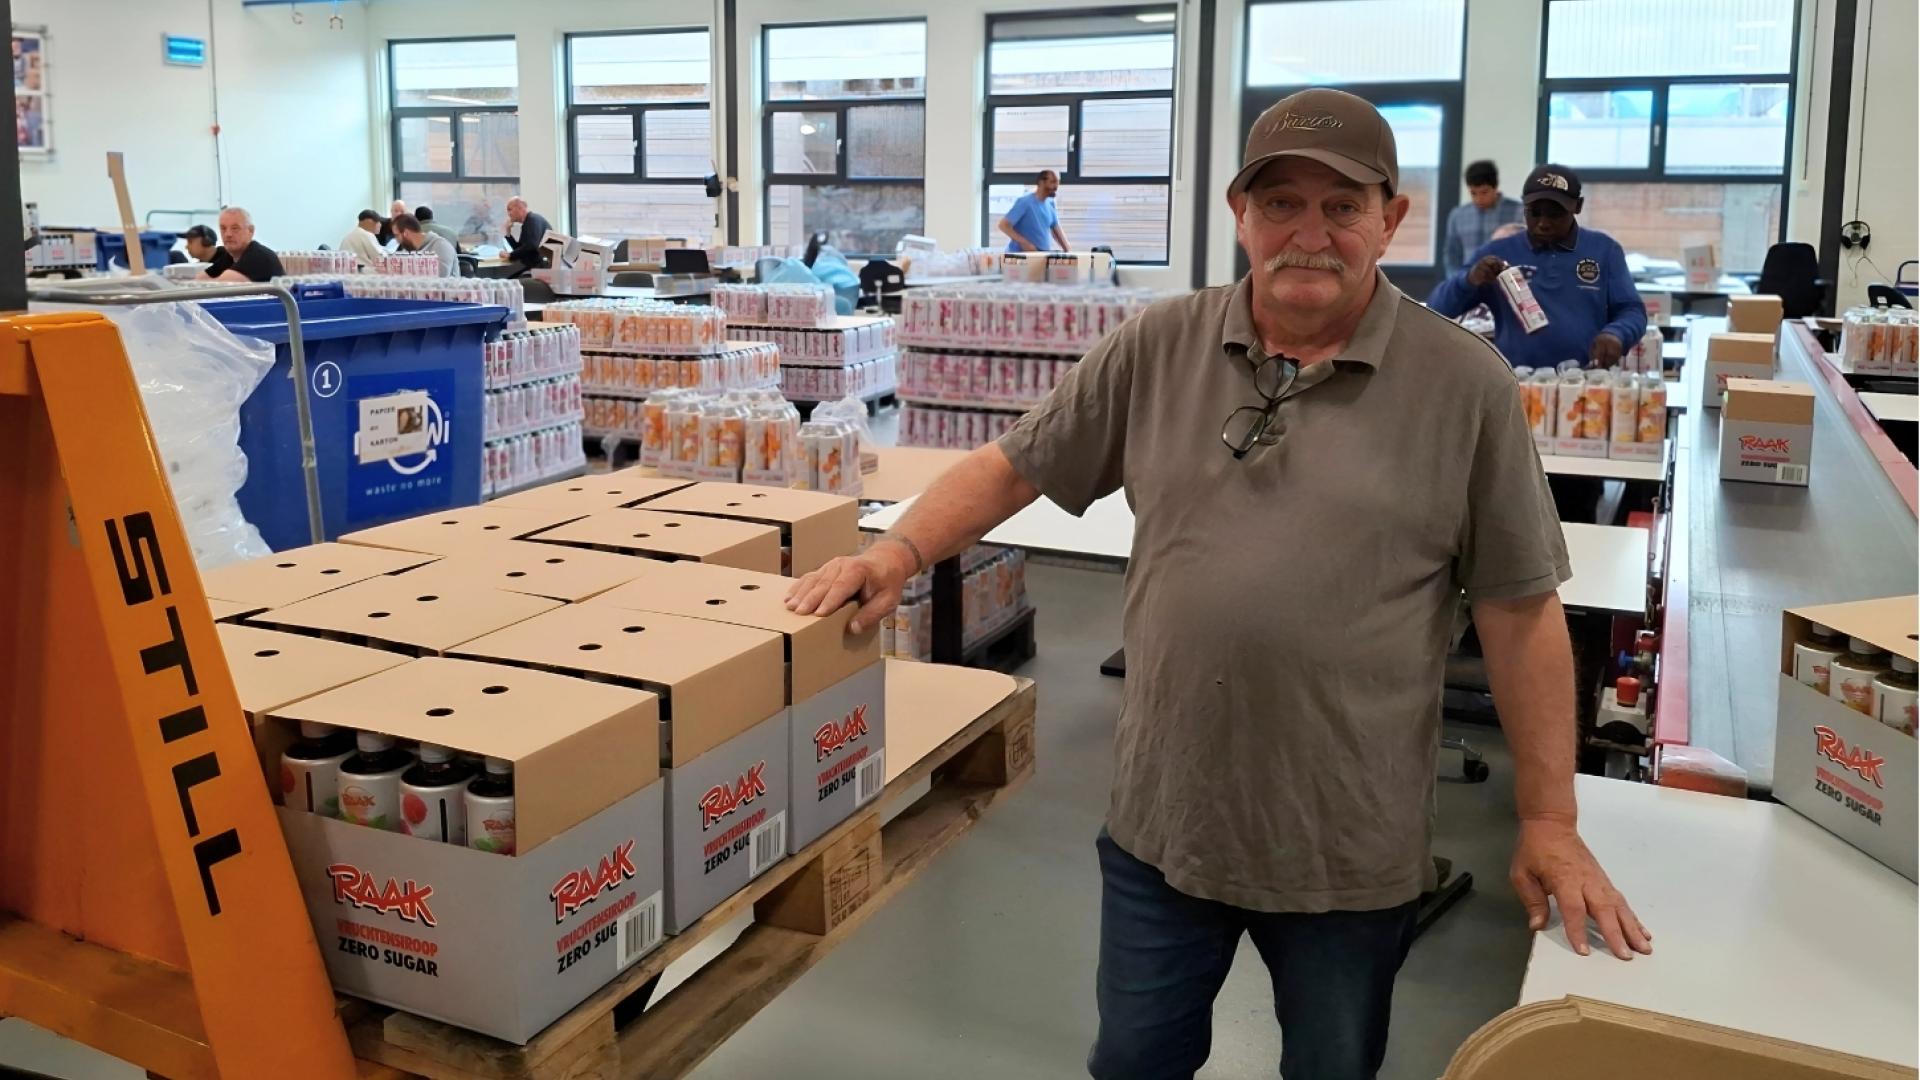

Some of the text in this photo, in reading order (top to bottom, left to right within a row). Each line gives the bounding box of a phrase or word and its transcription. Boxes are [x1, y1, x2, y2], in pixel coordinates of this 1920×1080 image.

[322, 369, 332, 388] 1
[1739, 435, 1790, 453] RAAK
[104, 511, 241, 916] STILL
[814, 702, 869, 763] RAAK
[1813, 724, 1885, 788] RAAK
[699, 760, 766, 832] RAAK
[818, 777, 839, 802] ZERO
[1815, 778, 1843, 803] ZERO
[1845, 795, 1883, 827] SUGAR
[549, 839, 637, 925] RAAK
[704, 845, 731, 875] ZERO
[327, 863, 437, 928] RAAK
[337, 936, 439, 978] ZERO SUGAR
[557, 921, 617, 974] ZERO SUG
